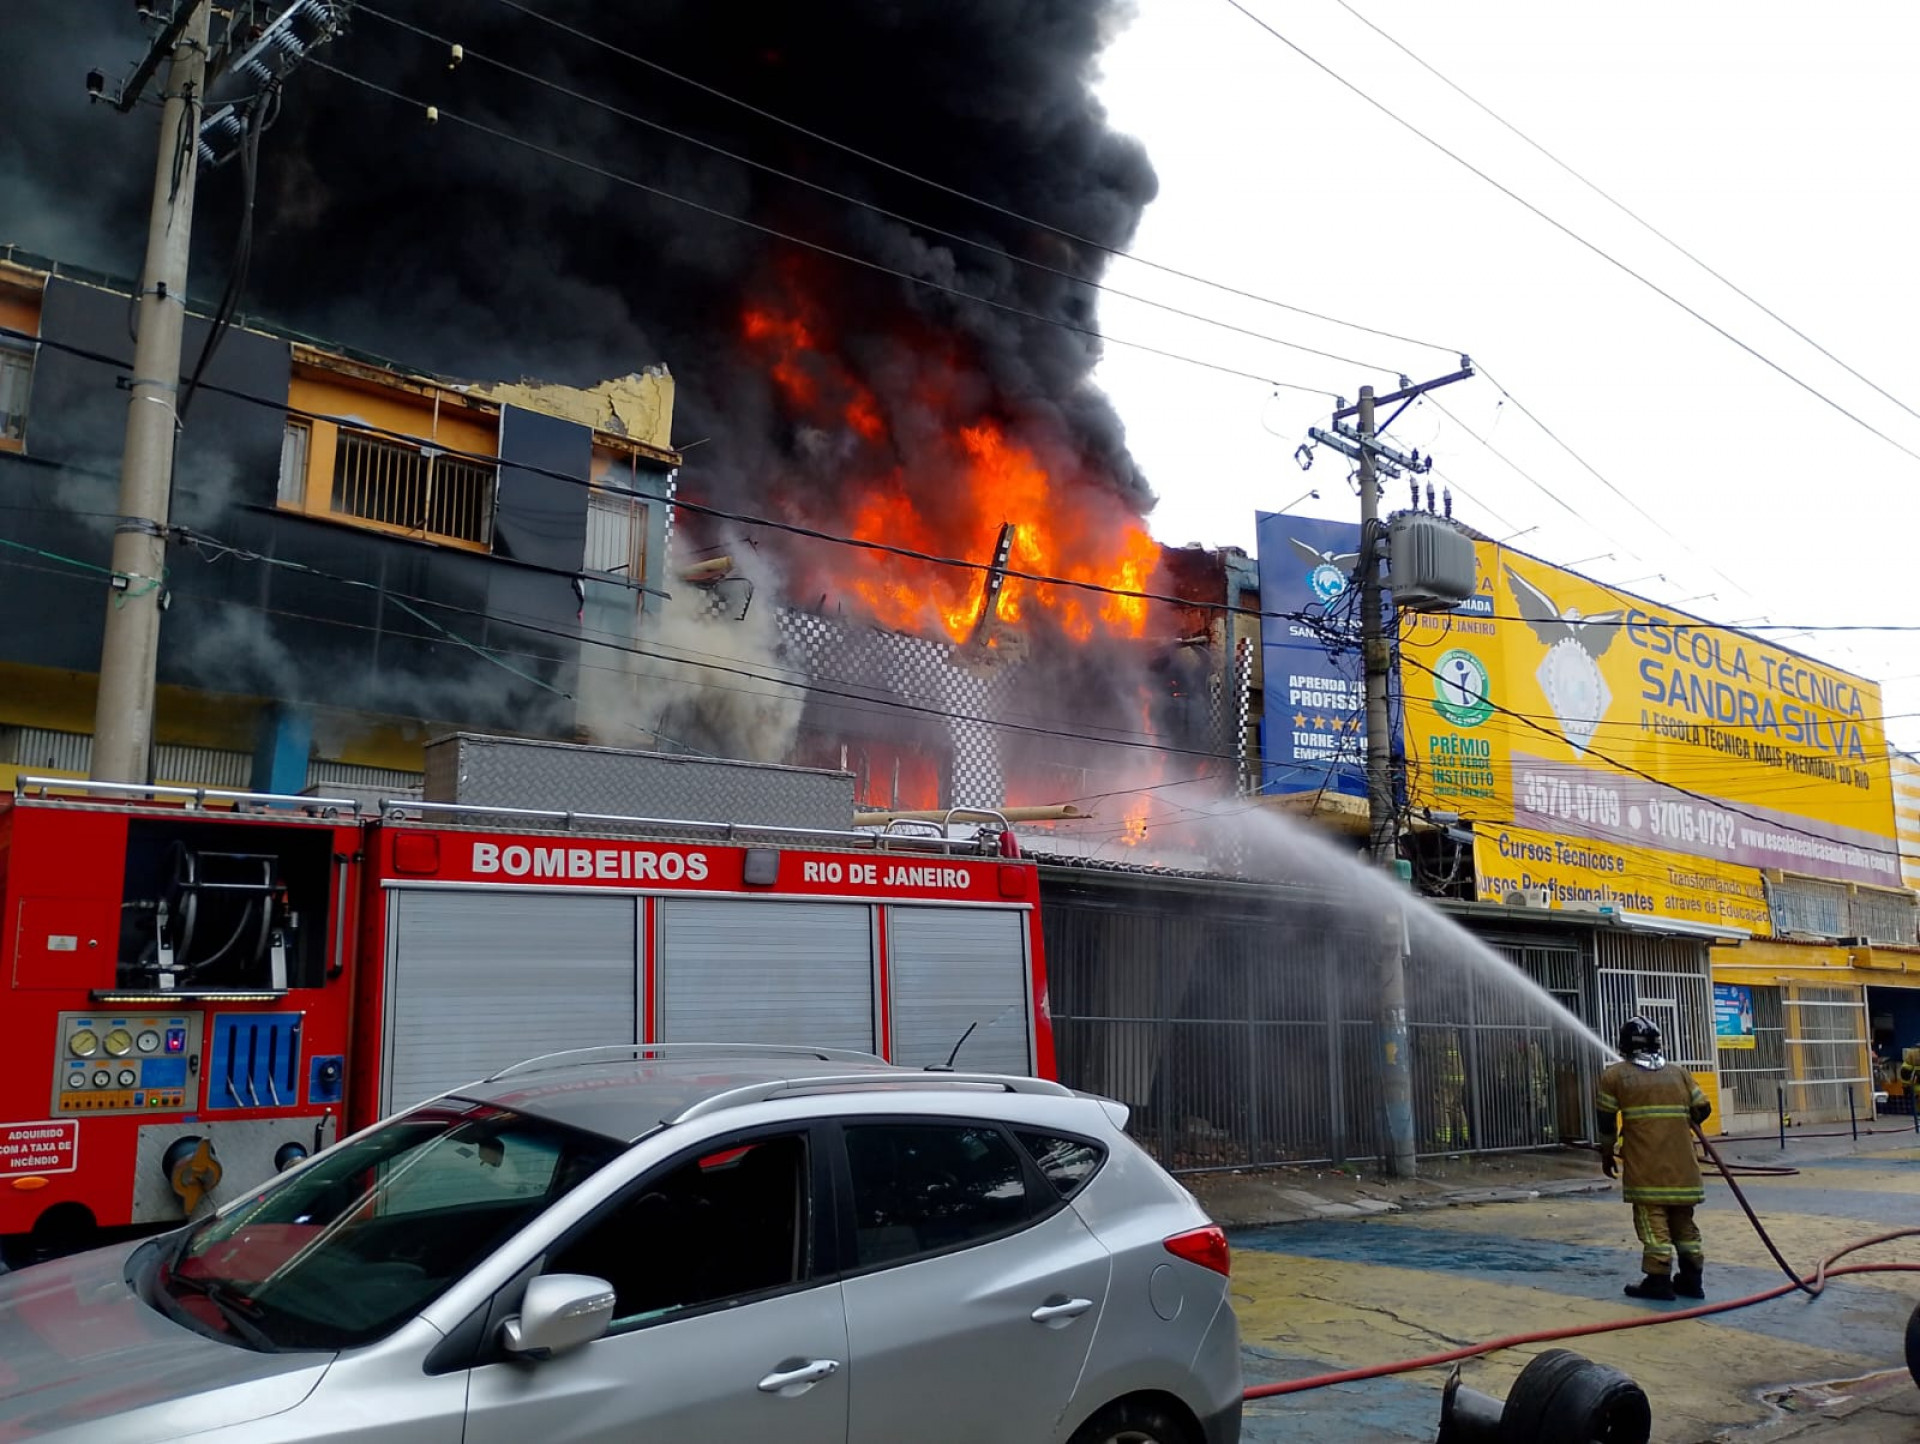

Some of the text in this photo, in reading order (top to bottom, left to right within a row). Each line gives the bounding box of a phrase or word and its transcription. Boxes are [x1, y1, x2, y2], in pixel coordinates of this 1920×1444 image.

[1421, 616, 1438, 629] RIO
[1457, 620, 1496, 636] JANEIRO
[1627, 608, 1865, 720] ESCOLA TÉCNICA
[1289, 675, 1347, 692] APRENDA
[1430, 732, 1490, 758] PRÊMIO
[1653, 711, 1700, 746] ESCOLA
[1754, 741, 1782, 768] MAIS
[1785, 751, 1837, 781] PREMIADA
[1854, 769, 1869, 790] RIO
[1433, 769, 1494, 787] INSTITUTO
[1524, 771, 1736, 850] 3570-0709 97015-0732
[472, 842, 709, 881] BOMBEIROS
[1499, 832, 1625, 873] Cursos Técnicos e
[803, 861, 971, 889] RIO DE JANEIRO
[1704, 898, 1717, 914] da
[8, 1128, 64, 1140] ADQUIRIDO
[21, 1144, 28, 1153] A
[30, 1142, 56, 1152] TAXA
[58, 1141, 72, 1150] DE
[10, 1155, 59, 1168] INCÊNDIO
